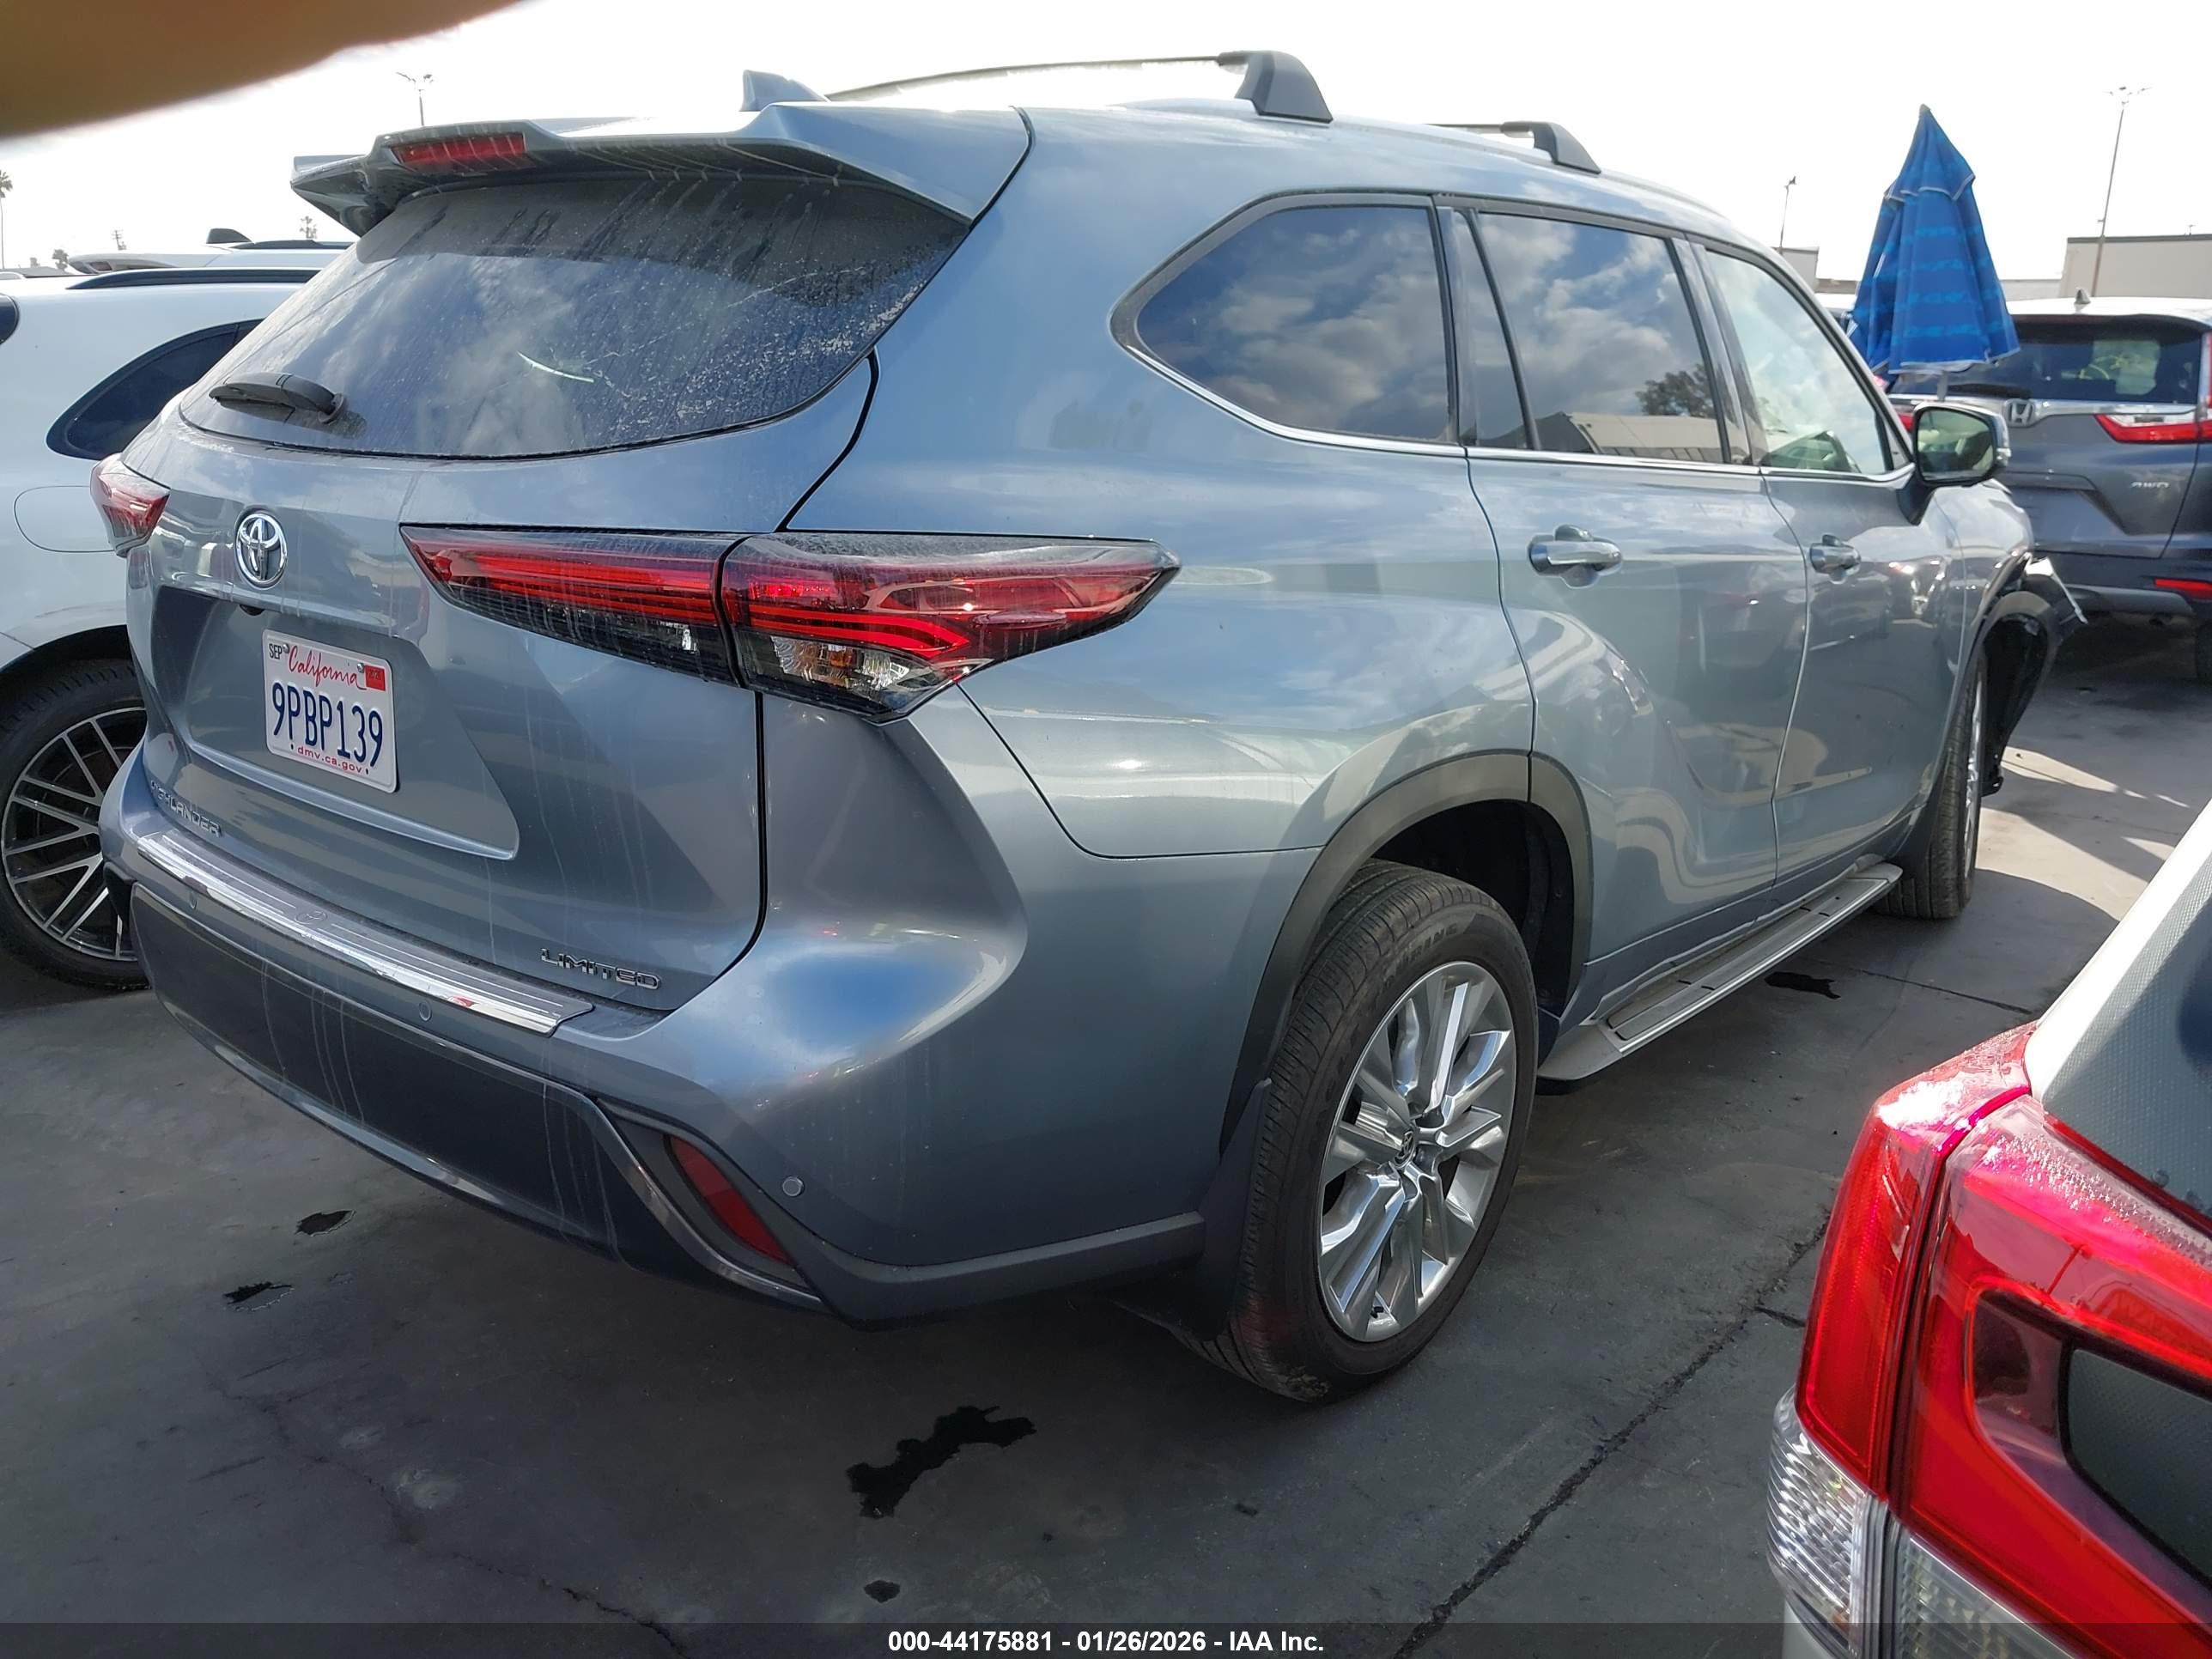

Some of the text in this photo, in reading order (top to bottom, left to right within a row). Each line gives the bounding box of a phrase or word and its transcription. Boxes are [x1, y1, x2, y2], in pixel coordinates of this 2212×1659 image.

[269, 643, 283, 660] SEP
[289, 645, 368, 690] California
[272, 682, 383, 768] 9PBP139
[297, 745, 362, 774] dmv.ca.gov
[541, 948, 660, 990] LIMITED
